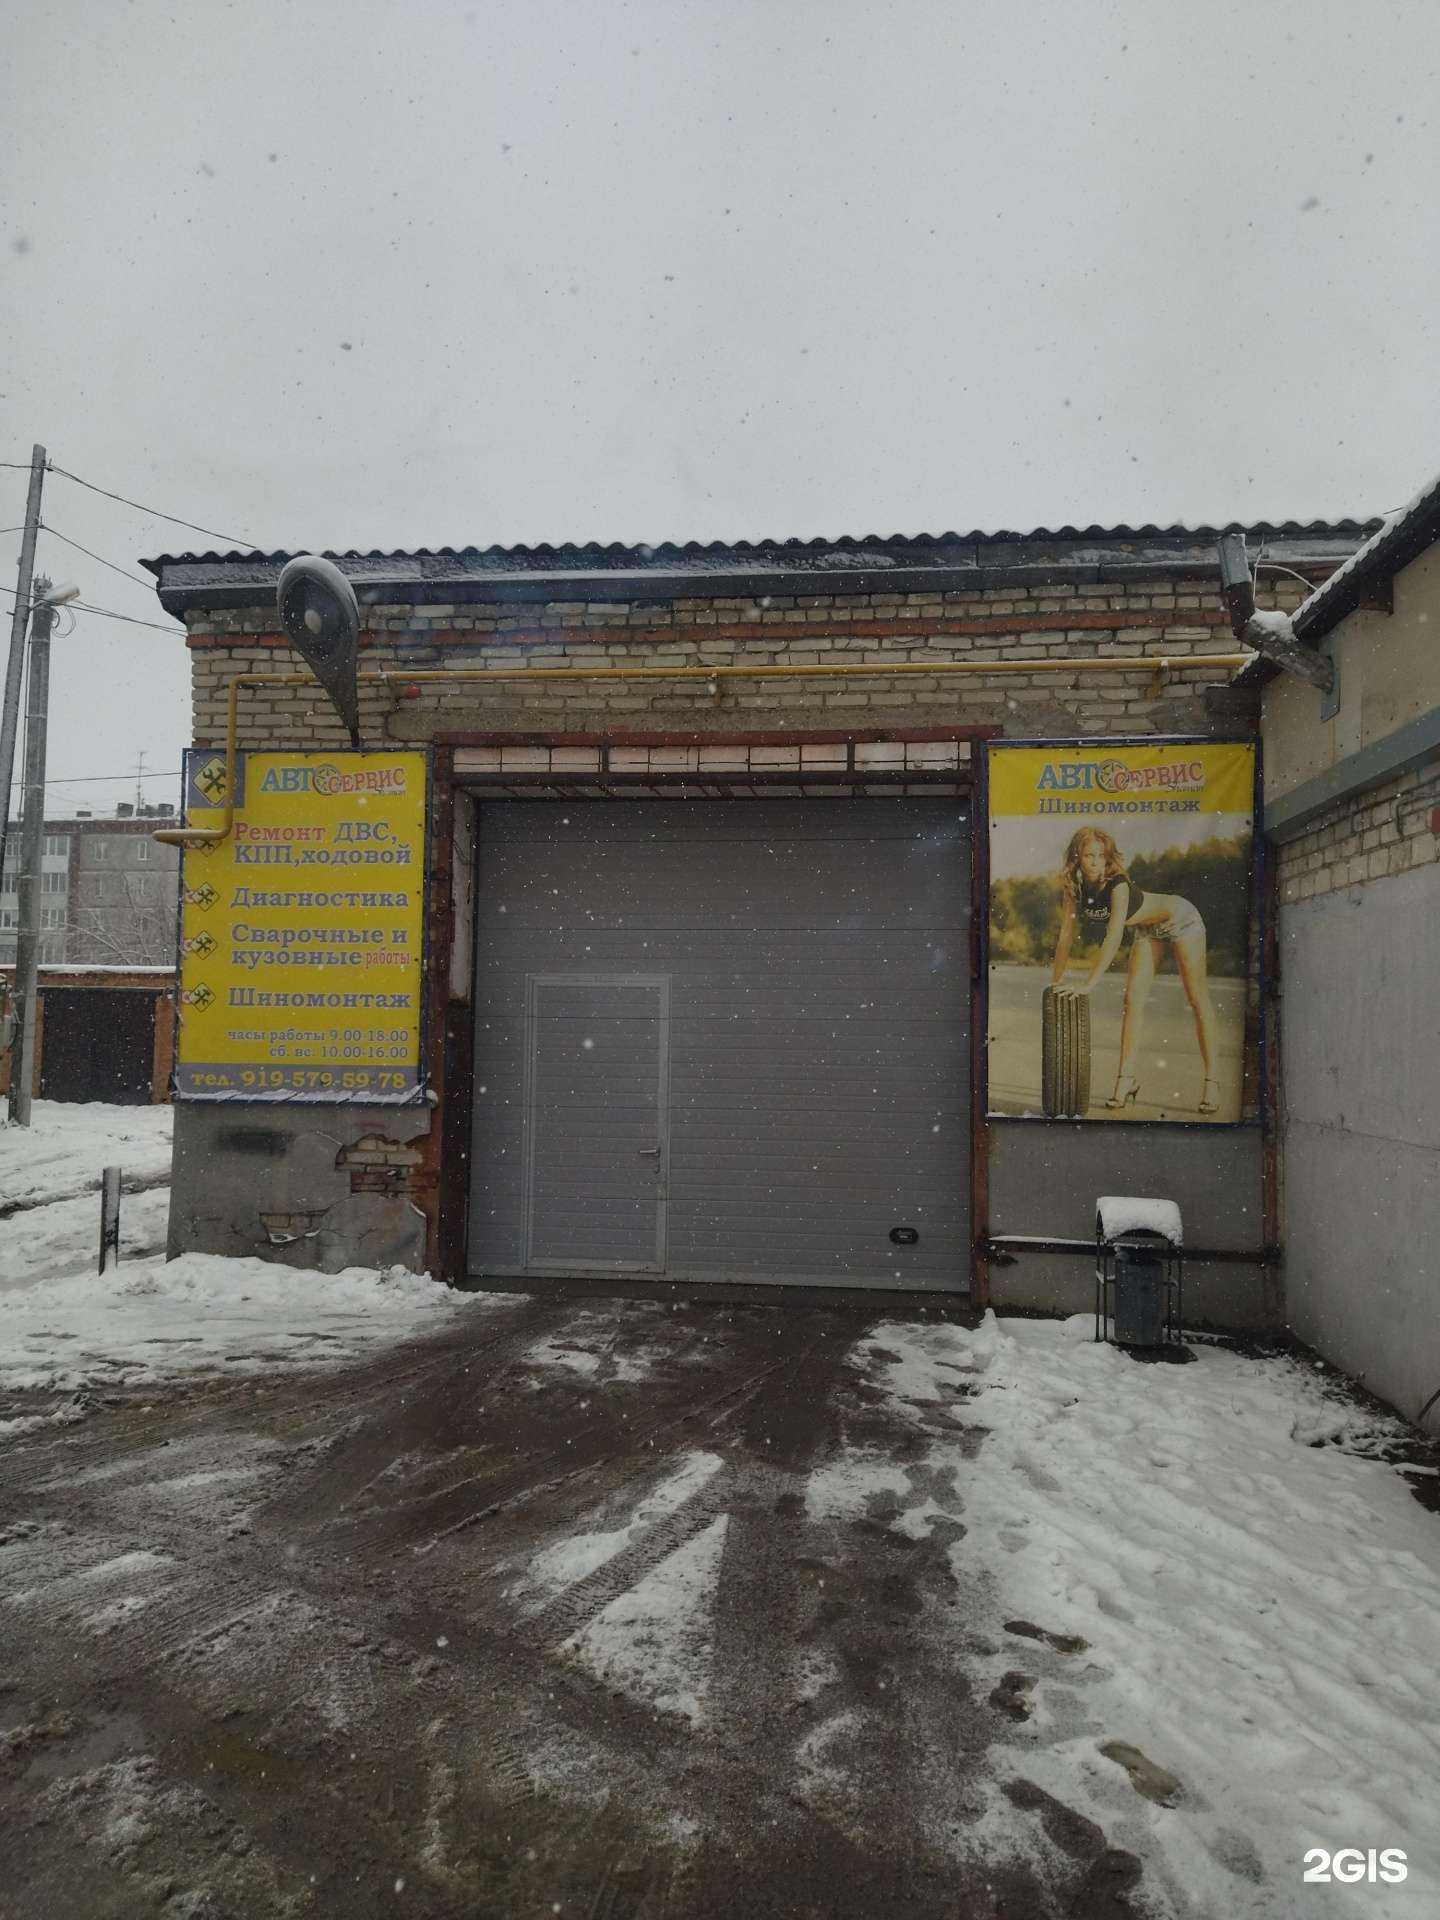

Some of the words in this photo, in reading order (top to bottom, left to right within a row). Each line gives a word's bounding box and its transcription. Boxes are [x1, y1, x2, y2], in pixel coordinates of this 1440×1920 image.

[1038, 798, 1201, 814] Шиномонтаж
[234, 822, 326, 841] Ремонт
[333, 822, 397, 844] ДВС,
[234, 843, 412, 867] КПП,ходовой
[230, 887, 408, 908] Диагностика
[231, 924, 384, 948] Сварочные
[391, 928, 407, 944] и
[231, 950, 362, 970] кузовные
[365, 947, 410, 969] работы
[228, 987, 412, 1008] Шиномонтаж
[227, 1030, 265, 1041] часы
[269, 1028, 325, 1043] работы
[269, 1047, 289, 1058] сб.
[191, 1073, 235, 1087] тел.
[241, 1071, 407, 1089] 919-579-59-78
